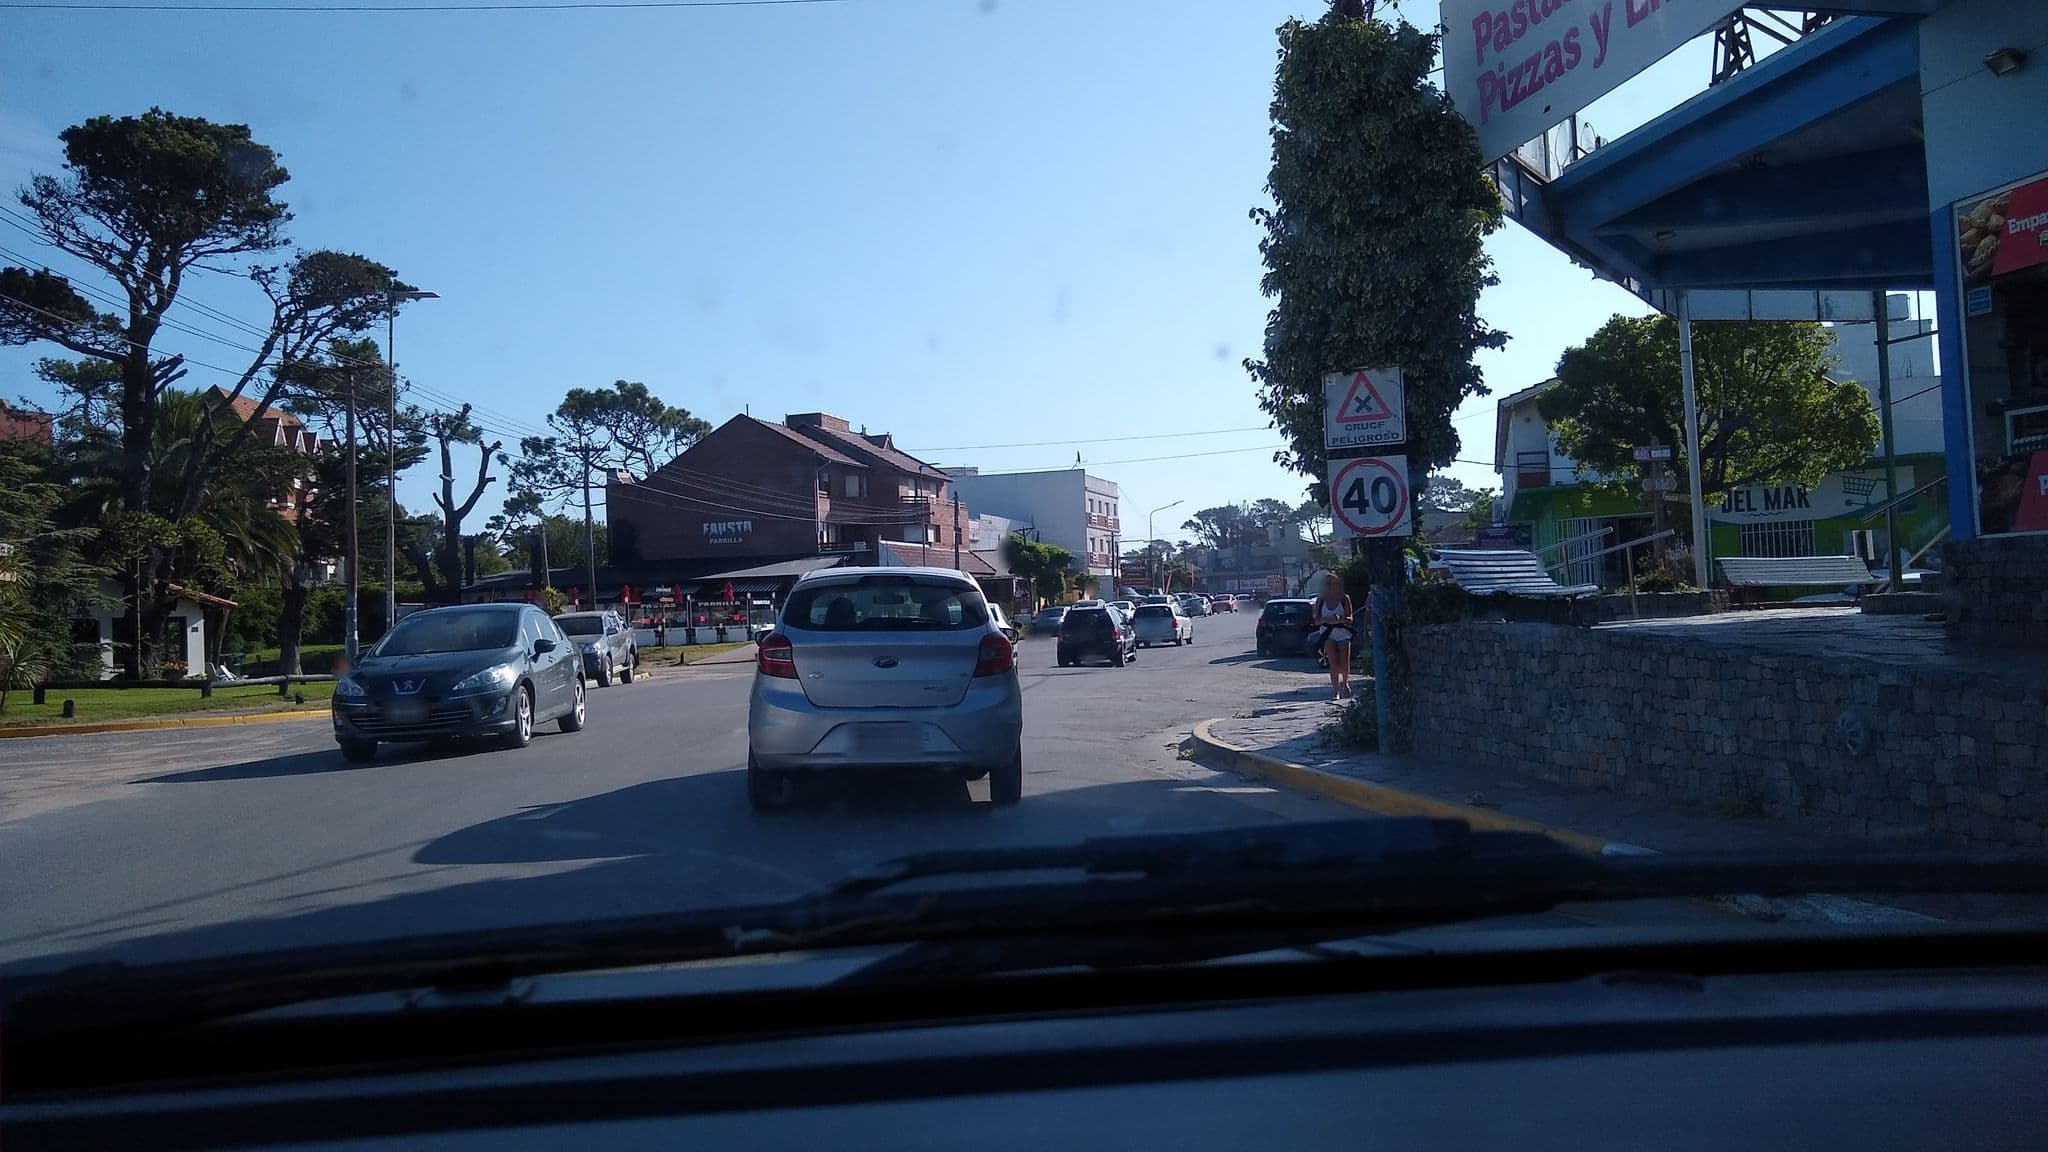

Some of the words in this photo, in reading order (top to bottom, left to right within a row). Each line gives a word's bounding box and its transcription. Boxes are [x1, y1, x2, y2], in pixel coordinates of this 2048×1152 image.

[1476, 25, 1583, 125] Pizzas
[1589, 2, 1612, 69] y
[2007, 211, 2048, 235] Empa
[1331, 432, 1400, 445] PELIGROSO
[1342, 476, 1397, 515] 40
[1721, 488, 1757, 513] DEL
[703, 521, 752, 536] FAUSTA
